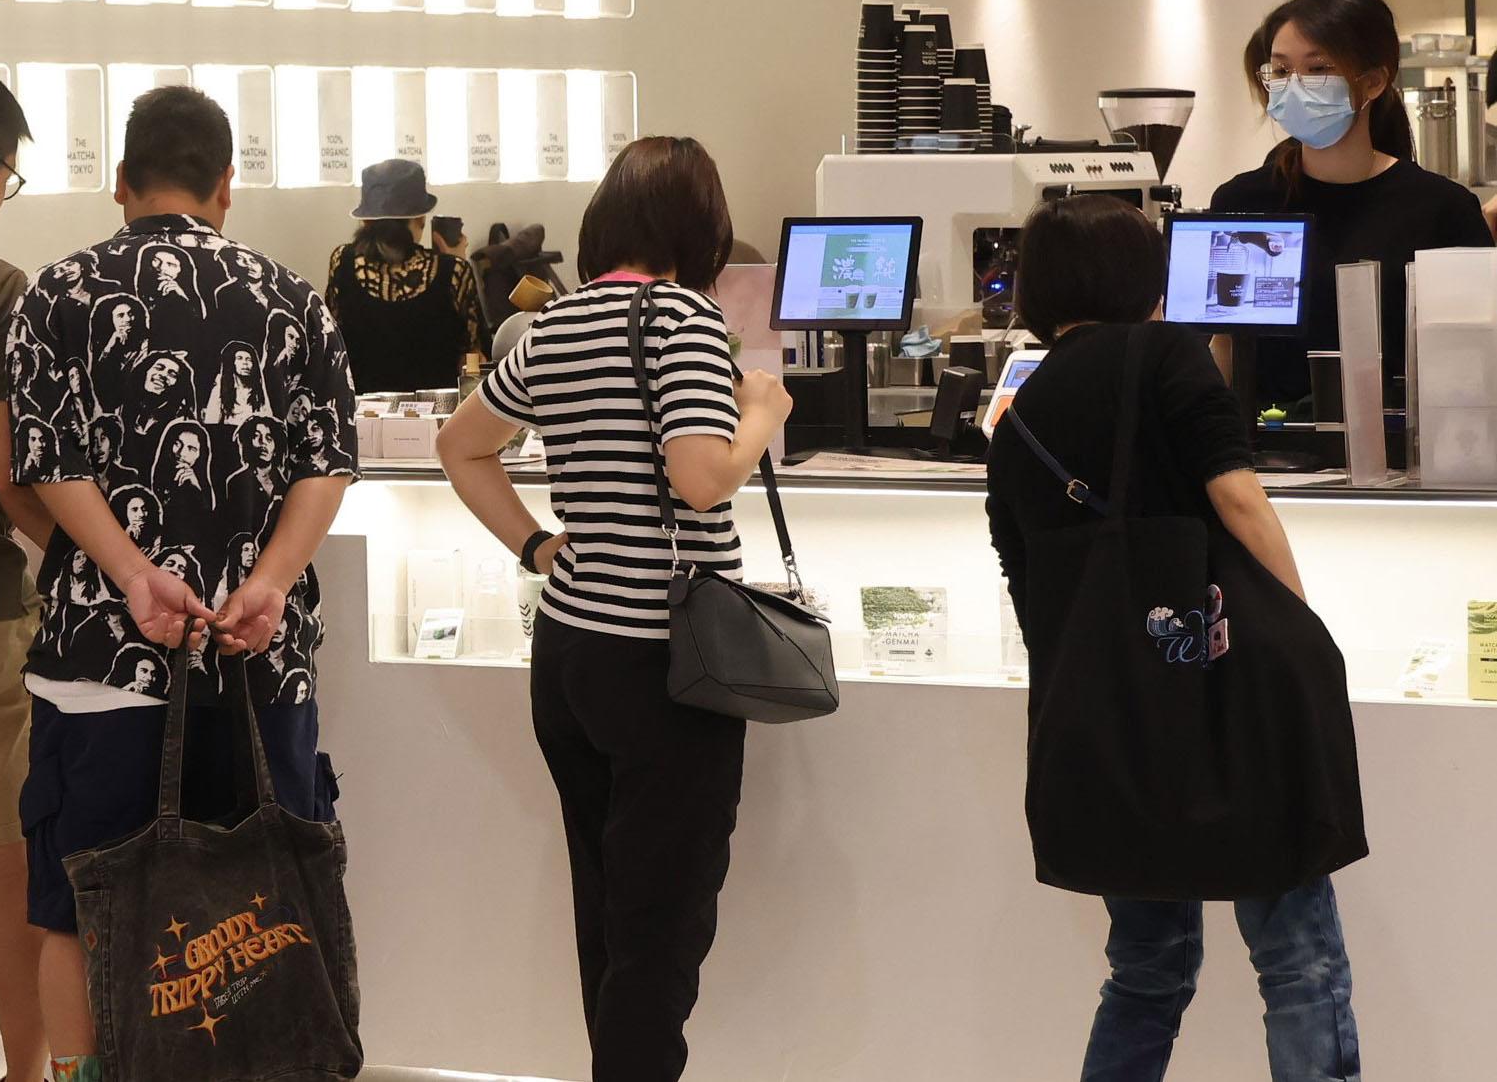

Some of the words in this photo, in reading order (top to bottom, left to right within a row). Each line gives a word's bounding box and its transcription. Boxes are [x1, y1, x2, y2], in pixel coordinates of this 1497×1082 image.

[241, 148, 267, 157] MATCHA
[70, 164, 94, 174] TOKYO
[150, 956, 228, 1016] TRIPPY
